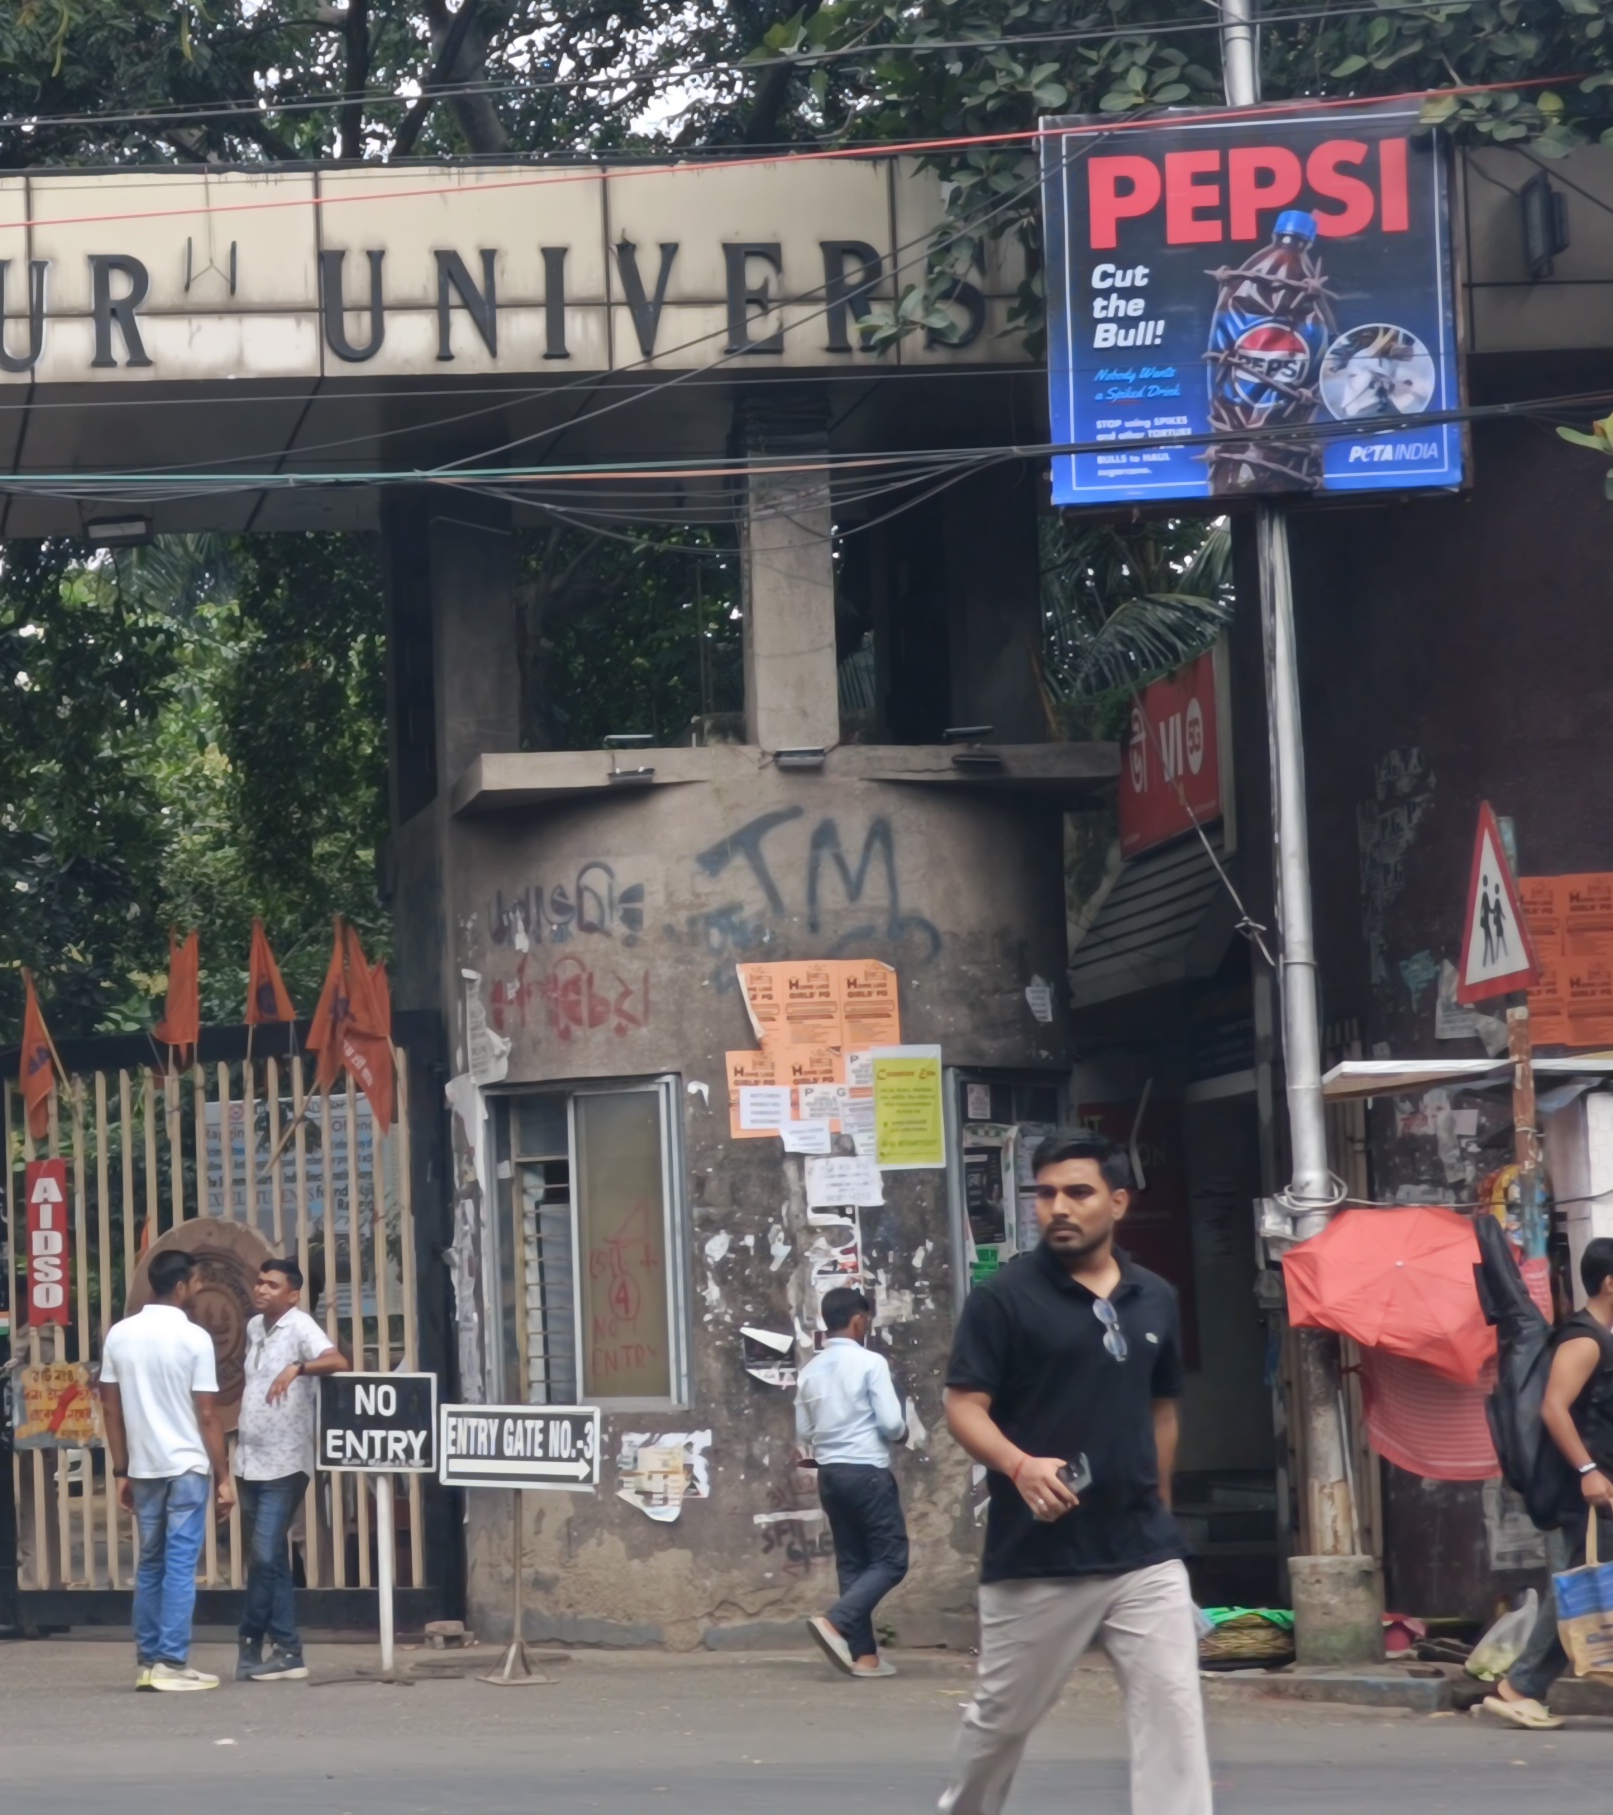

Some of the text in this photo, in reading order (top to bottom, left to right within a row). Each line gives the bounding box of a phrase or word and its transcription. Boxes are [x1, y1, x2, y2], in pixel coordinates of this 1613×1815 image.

[1088, 137, 1409, 249] PEPSI
[1091, 263, 1150, 290] Cut
[1092, 293, 1146, 319] the
[1093, 320, 1165, 349] Bull!
[1093, 367, 1136, 384] Nobody
[1096, 419, 1122, 429] STOP
[30, 1177, 64, 1309] AIDSO
[354, 1384, 396, 1417] NO
[326, 1429, 427, 1461] ENTRY
[448, 1417, 499, 1456] ENTRY
[503, 1418, 544, 1457] GATE
